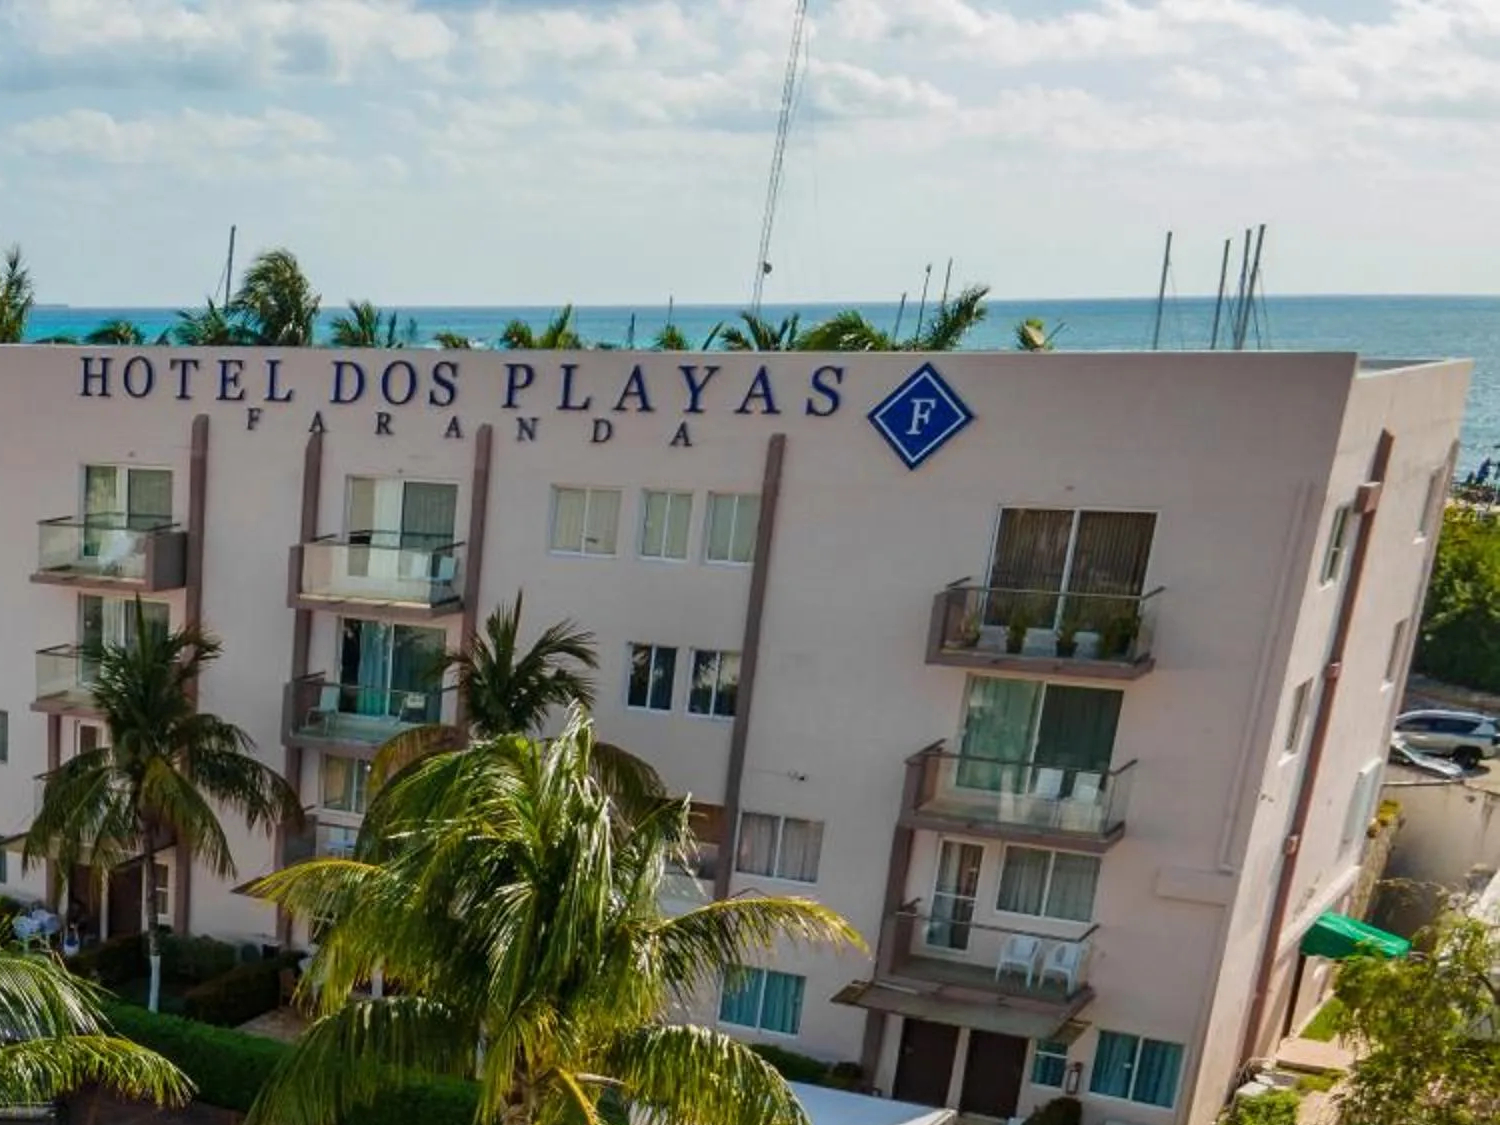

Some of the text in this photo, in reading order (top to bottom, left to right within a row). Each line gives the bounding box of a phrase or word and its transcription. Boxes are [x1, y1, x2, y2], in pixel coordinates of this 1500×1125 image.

[79, 354, 845, 418] HOTEL DOS PLAYAS
[246, 406, 694, 448] FARANDA
[904, 397, 937, 436] F
